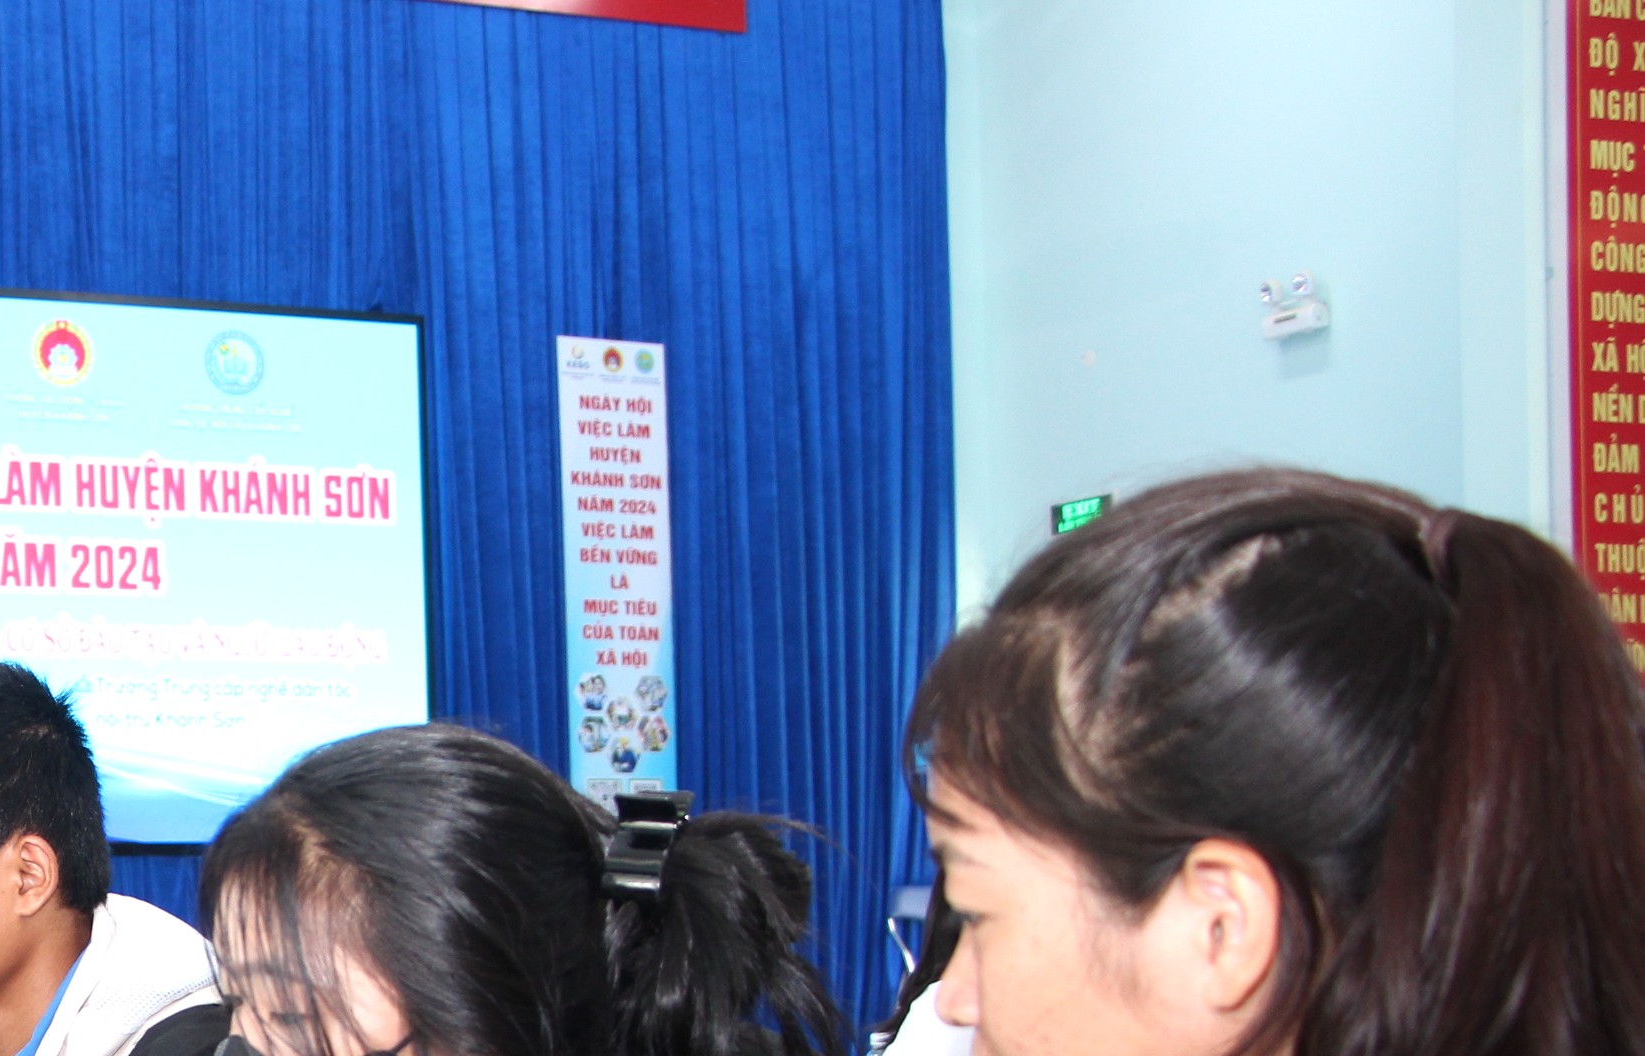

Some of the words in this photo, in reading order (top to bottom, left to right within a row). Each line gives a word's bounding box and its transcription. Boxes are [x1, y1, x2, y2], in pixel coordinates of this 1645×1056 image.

[1589, 32, 1618, 76] ĐỘ
[1590, 86, 1645, 122] NGHĨ
[1590, 139, 1635, 178] MỤC
[1591, 336, 1619, 372] XÃ
[579, 393, 620, 411] NGÀY
[626, 396, 652, 416] HỘI
[578, 419, 612, 439] VIỆC
[618, 420, 650, 438] LÀM
[590, 446, 641, 465] HUYỆN
[1593, 433, 1639, 473] ĐẢM
[75, 458, 186, 522] HUYỆN
[200, 463, 311, 517] KHÁNH
[324, 471, 390, 519] SƠN
[571, 469, 624, 487] KHÁNH
[630, 473, 661, 489] SƠN
[578, 494, 613, 512] NĂM
[620, 499, 656, 514] 2024
[1594, 484, 1644, 524] CHỦ
[581, 522, 615, 542] VIỆC
[621, 522, 654, 539] LÀM
[580, 544, 611, 564] BỀN
[616, 546, 658, 565] VỮNG
[1594, 537, 1645, 581] THUỘ
[71, 543, 161, 590] 2024
[611, 572, 629, 590] LÀ
[584, 599, 618, 618] MỤC
[624, 597, 657, 615] TIÊU
[583, 621, 613, 640] CỦA
[619, 622, 659, 641] TOÀN
[596, 647, 616, 665] XÃ
[622, 649, 648, 668] HỘI
